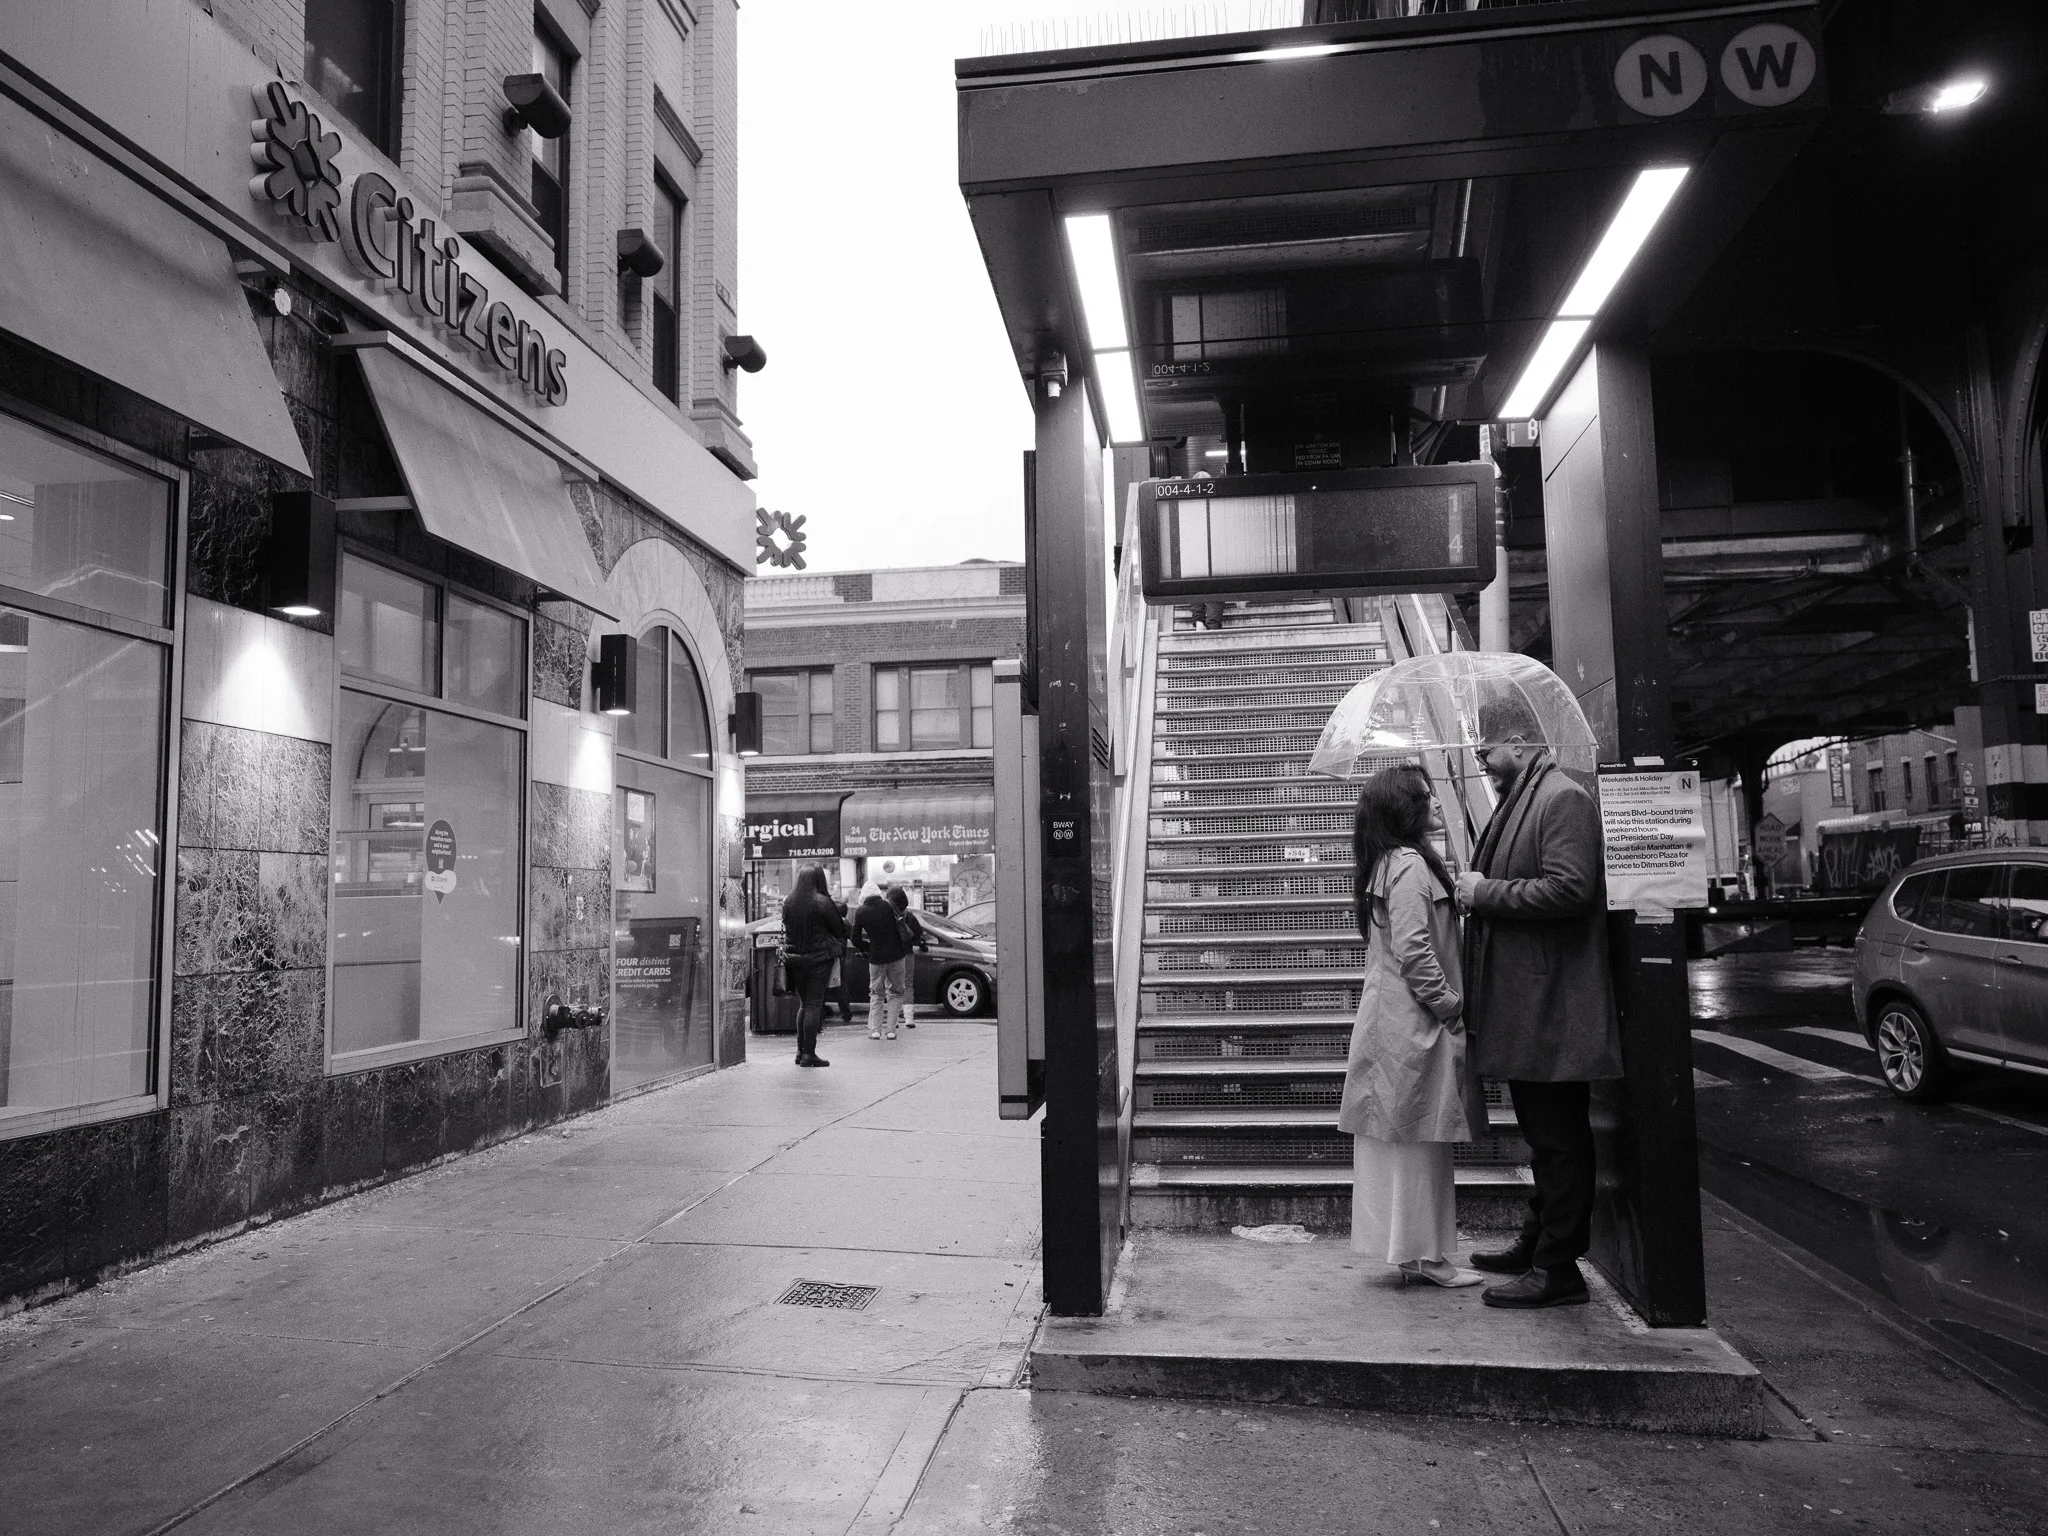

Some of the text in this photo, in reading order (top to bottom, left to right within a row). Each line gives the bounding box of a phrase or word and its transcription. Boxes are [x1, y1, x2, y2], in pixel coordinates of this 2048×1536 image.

[1639, 42, 1797, 98] N W
[342, 172, 568, 407] Citizens
[1158, 483, 1214, 496] 004-4-1-2
[1448, 534, 1463, 553] 4
[1682, 778, 1692, 789] N
[850, 826, 860, 834] 24
[869, 824, 989, 844] The New York Times
[844, 835, 867, 844] Hours
[788, 848, 834, 856] 718.274.9200
[616, 957, 670, 966] FOUR distinct
[644, 967, 671, 976] CARDS
